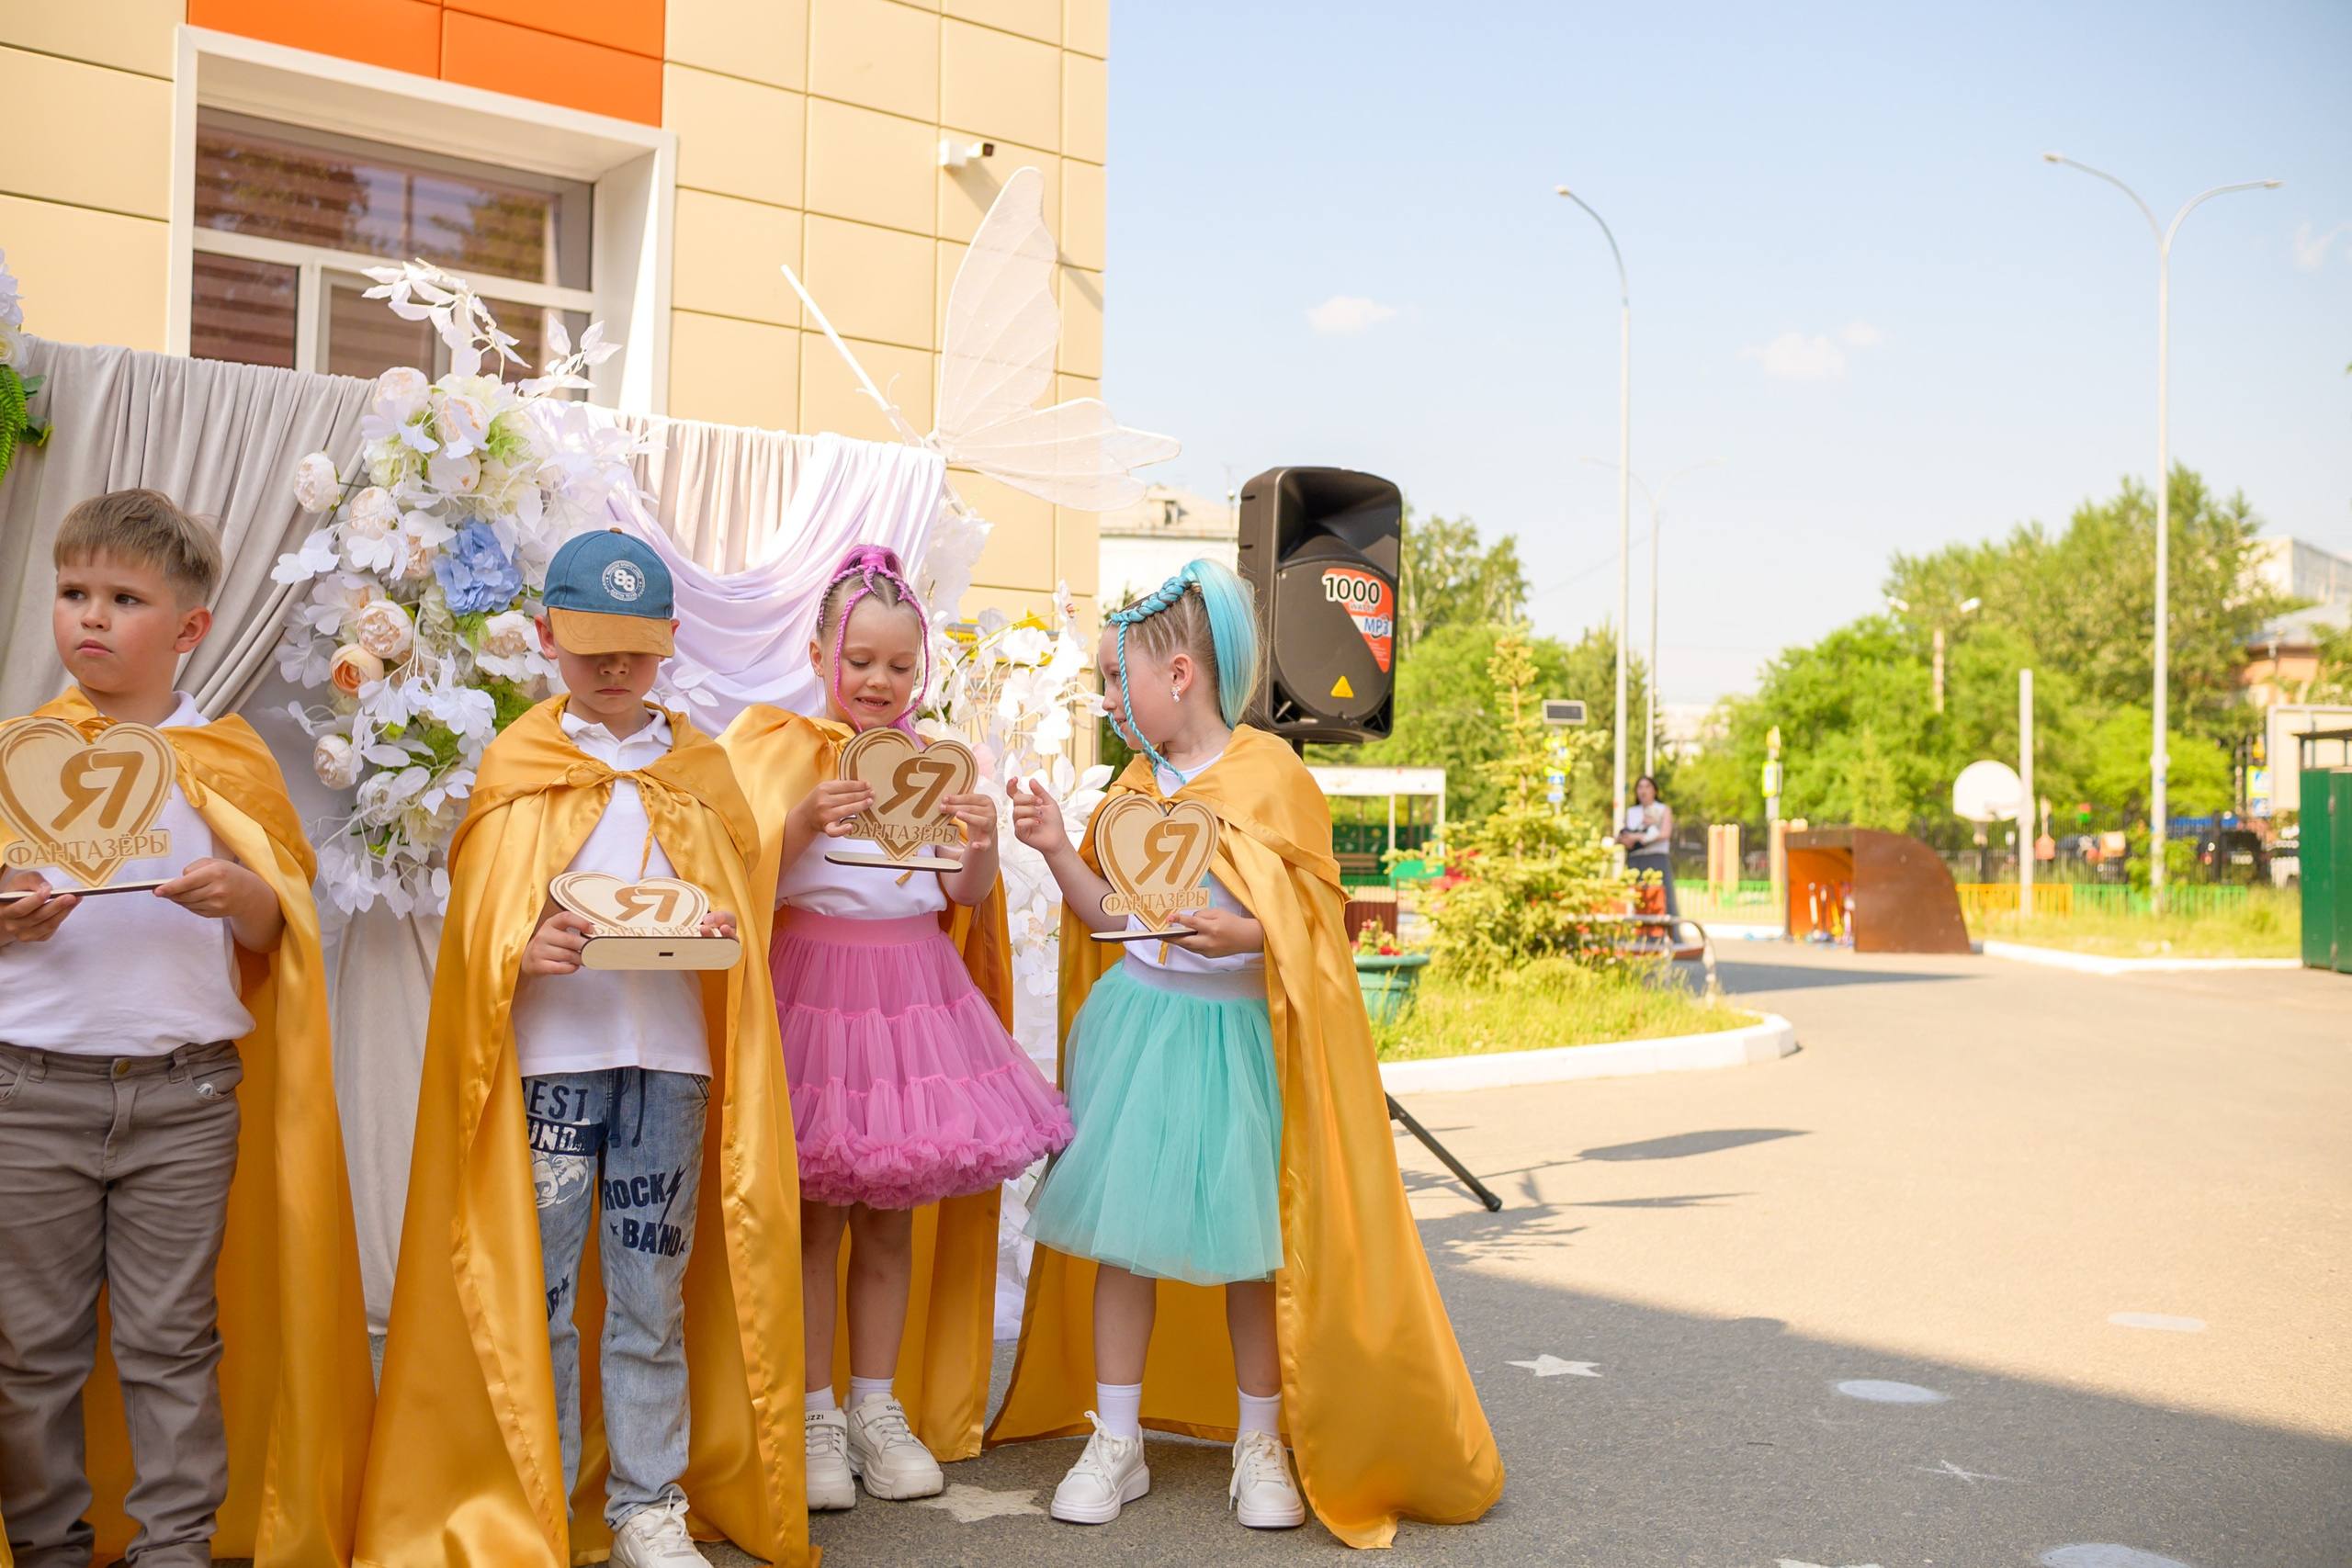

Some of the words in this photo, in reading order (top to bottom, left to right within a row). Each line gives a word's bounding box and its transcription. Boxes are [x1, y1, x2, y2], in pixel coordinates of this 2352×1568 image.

[1325, 576, 1381, 605] 1000
[1350, 603, 1375, 613] WATTS
[1363, 616, 1389, 636] MP3
[51, 748, 144, 831] Я
[878, 757, 956, 818] Я
[7, 833, 167, 865] ФАНТАЗЁРЫ
[1134, 819, 1200, 886] Я
[615, 886, 680, 923] Я
[1104, 889, 1208, 912] ФАНТАЗЁРЫ
[605, 1172, 666, 1211] ROCK
[622, 1217, 682, 1258] BAND
